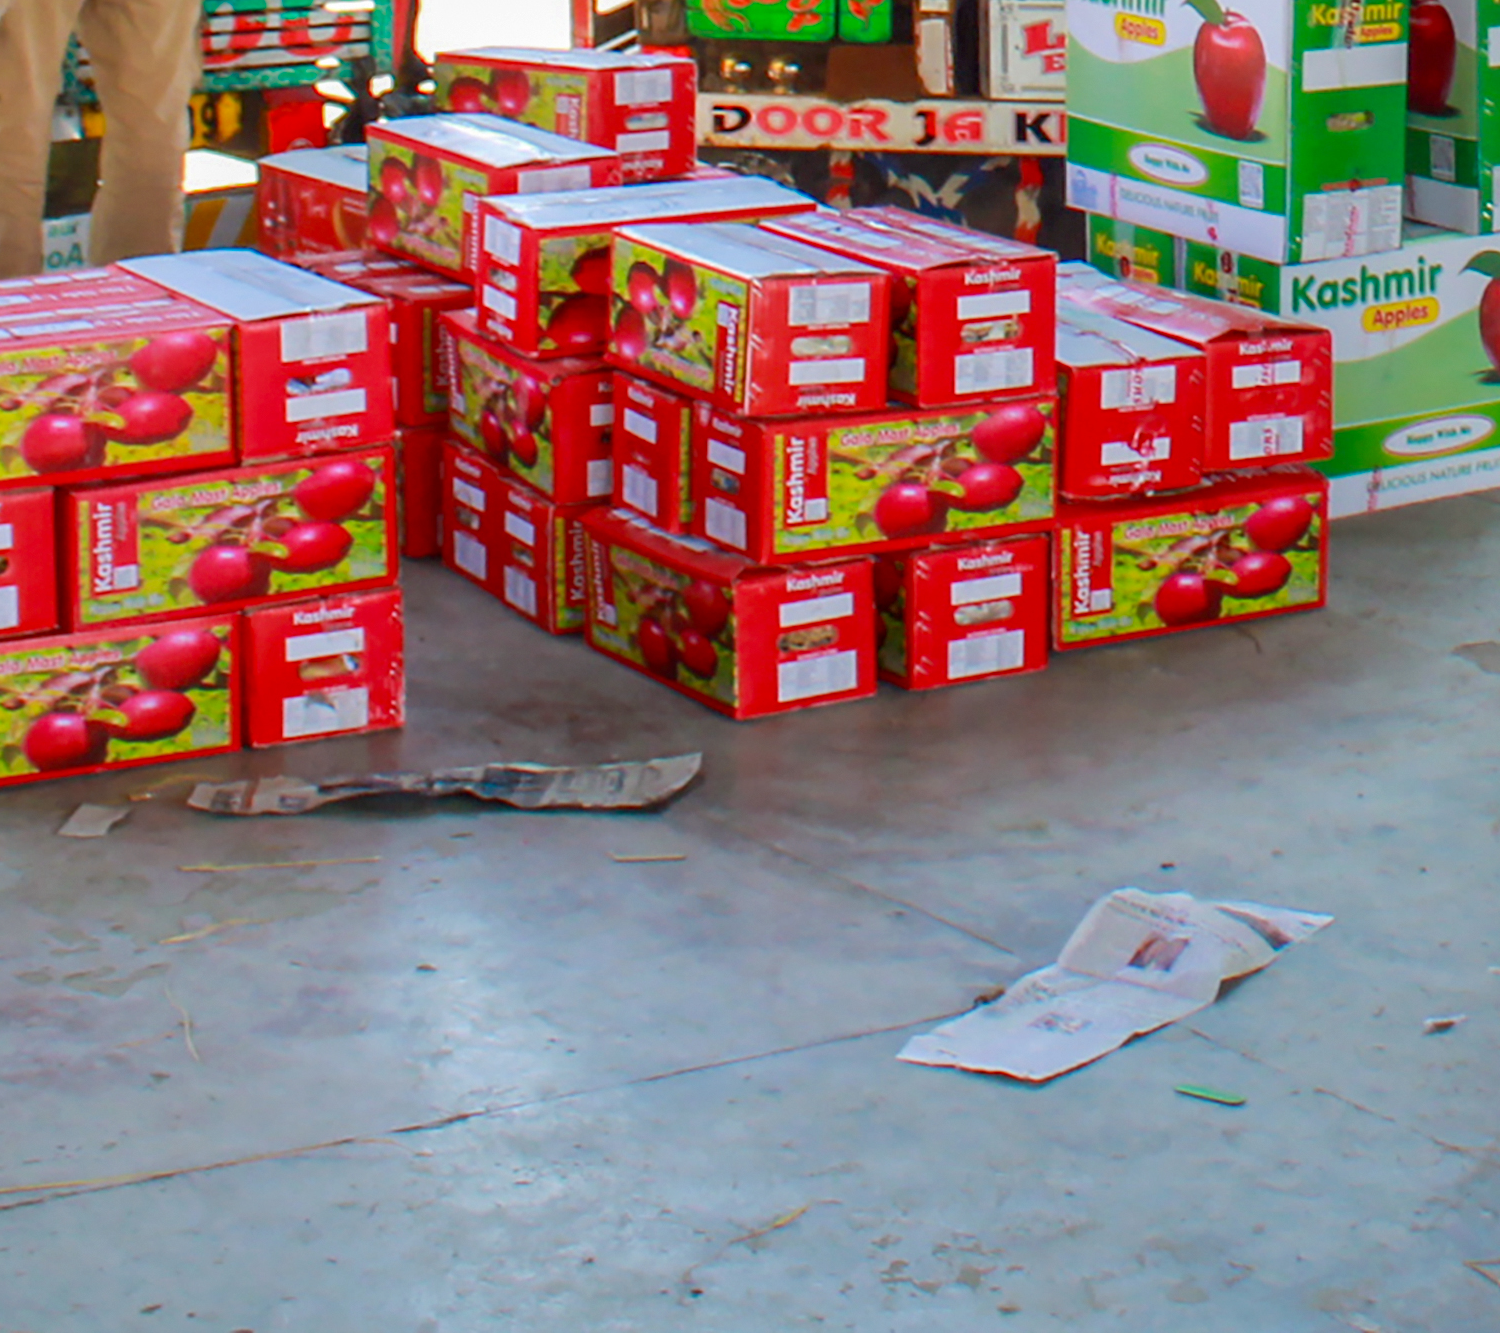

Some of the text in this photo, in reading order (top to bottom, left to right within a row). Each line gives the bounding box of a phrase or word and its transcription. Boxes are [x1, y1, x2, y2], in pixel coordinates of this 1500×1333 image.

[1119, 15, 1161, 42] Apples
[713, 104, 893, 133] DOOR
[964, 267, 1022, 285] Kashmir
[1290, 258, 1443, 313] Kashmir
[1371, 300, 1429, 328] Apples
[720, 305, 739, 397] Kashmir
[786, 435, 806, 525] Kashmir
[94, 501, 115, 596] Kashmir
[956, 551, 1014, 571] Kashmir
[786, 568, 845, 593] Kashmir
[1074, 530, 1090, 614] Kashmir
[293, 603, 356, 627] Kashmir
[24, 653, 65, 675] Mast
[68, 646, 122, 669] Apples
